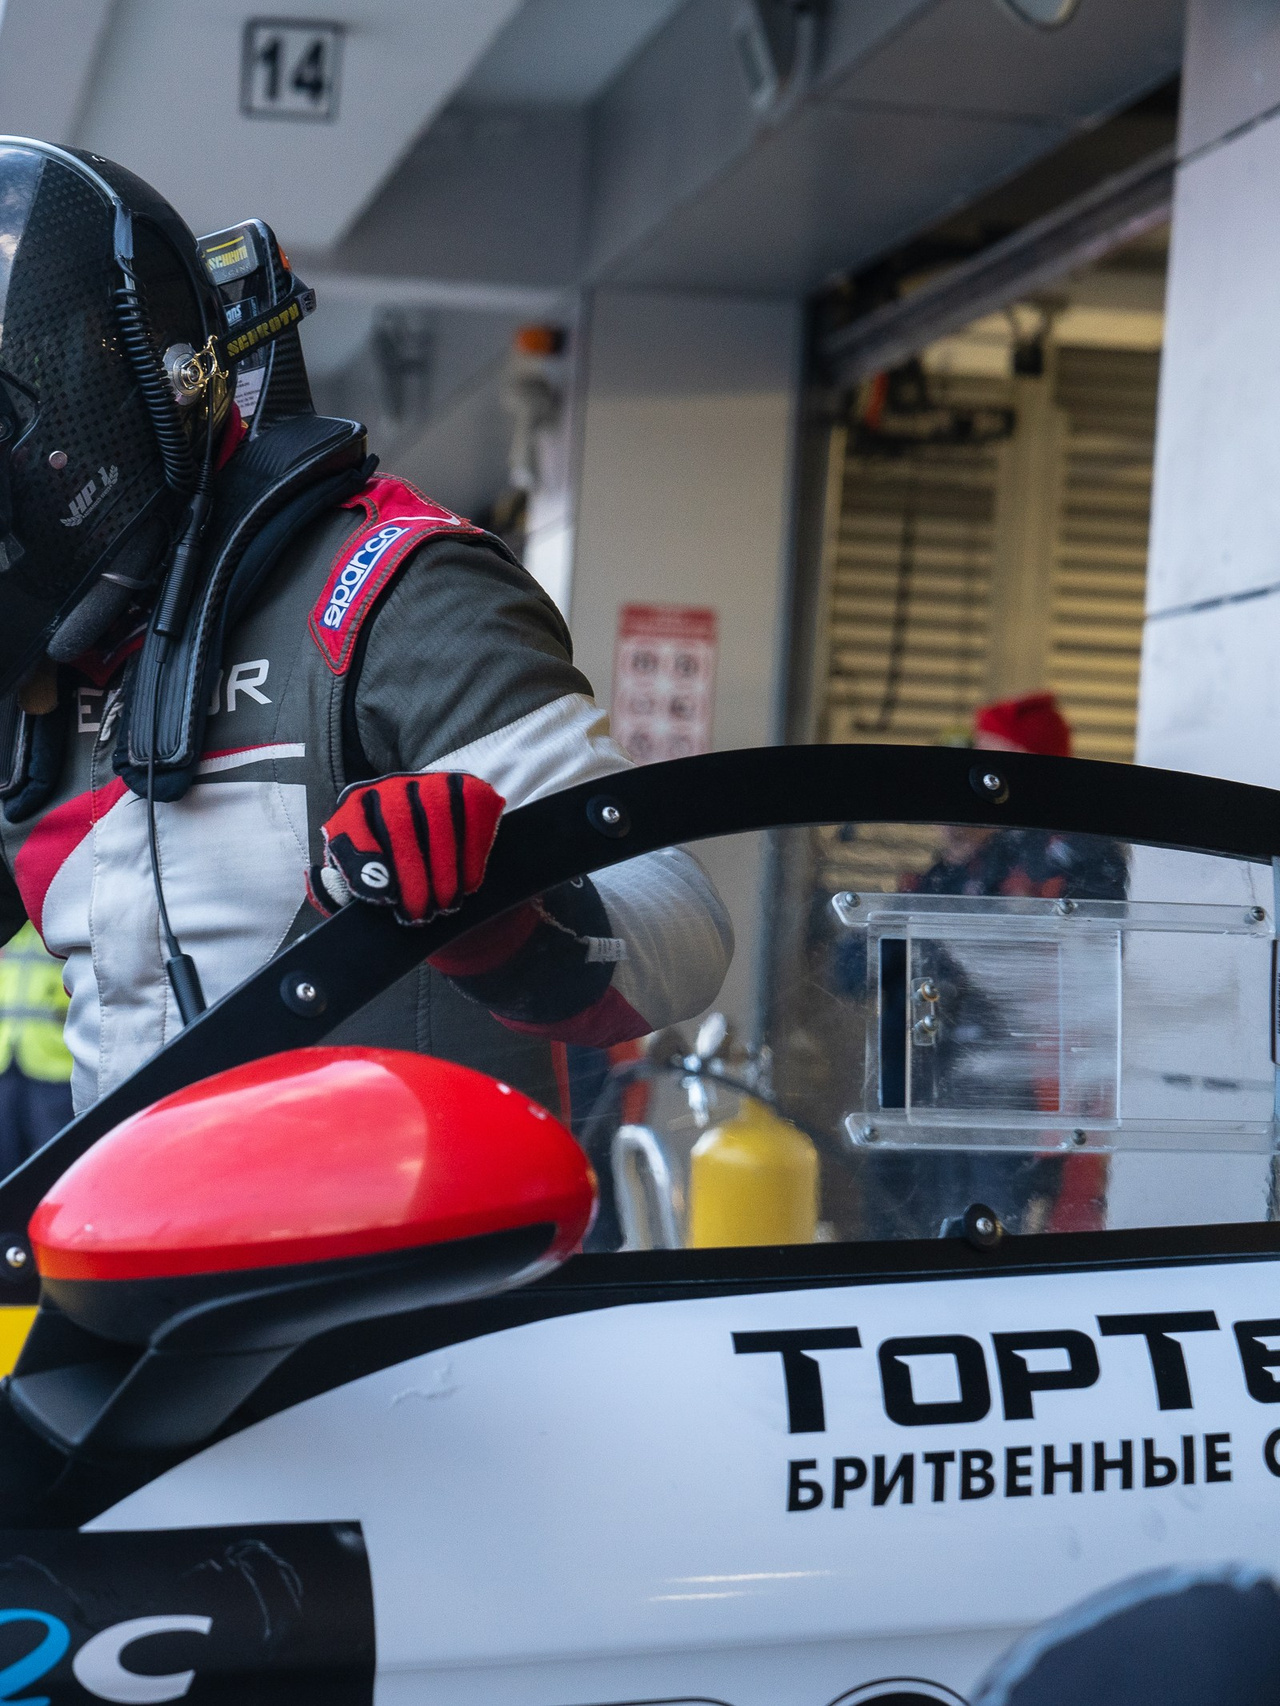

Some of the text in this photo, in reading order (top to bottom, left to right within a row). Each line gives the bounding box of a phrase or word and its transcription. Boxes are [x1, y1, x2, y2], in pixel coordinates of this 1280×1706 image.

[259, 37, 324, 104] 14
[227, 303, 299, 357] SCHROTH
[69, 480, 97, 516] HP
[323, 527, 411, 628] sparco
[786, 1432, 1233, 1512] БРИТВЕННЫЕ
